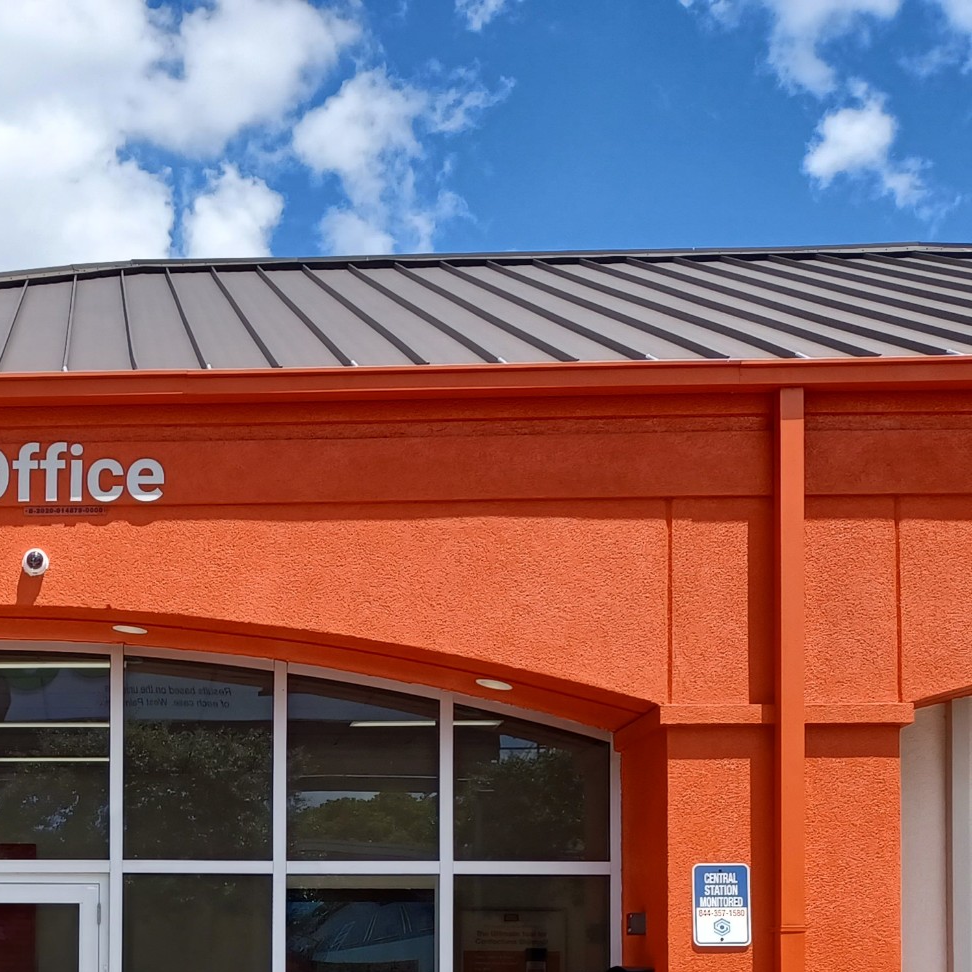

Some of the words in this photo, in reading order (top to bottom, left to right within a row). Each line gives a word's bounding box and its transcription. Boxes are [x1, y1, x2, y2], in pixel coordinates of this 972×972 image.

[704, 872, 738, 884] CENTRAL
[704, 884, 738, 896] STATION
[699, 896, 744, 908] MONITORED
[698, 909, 745, 917] 844-357-1580
